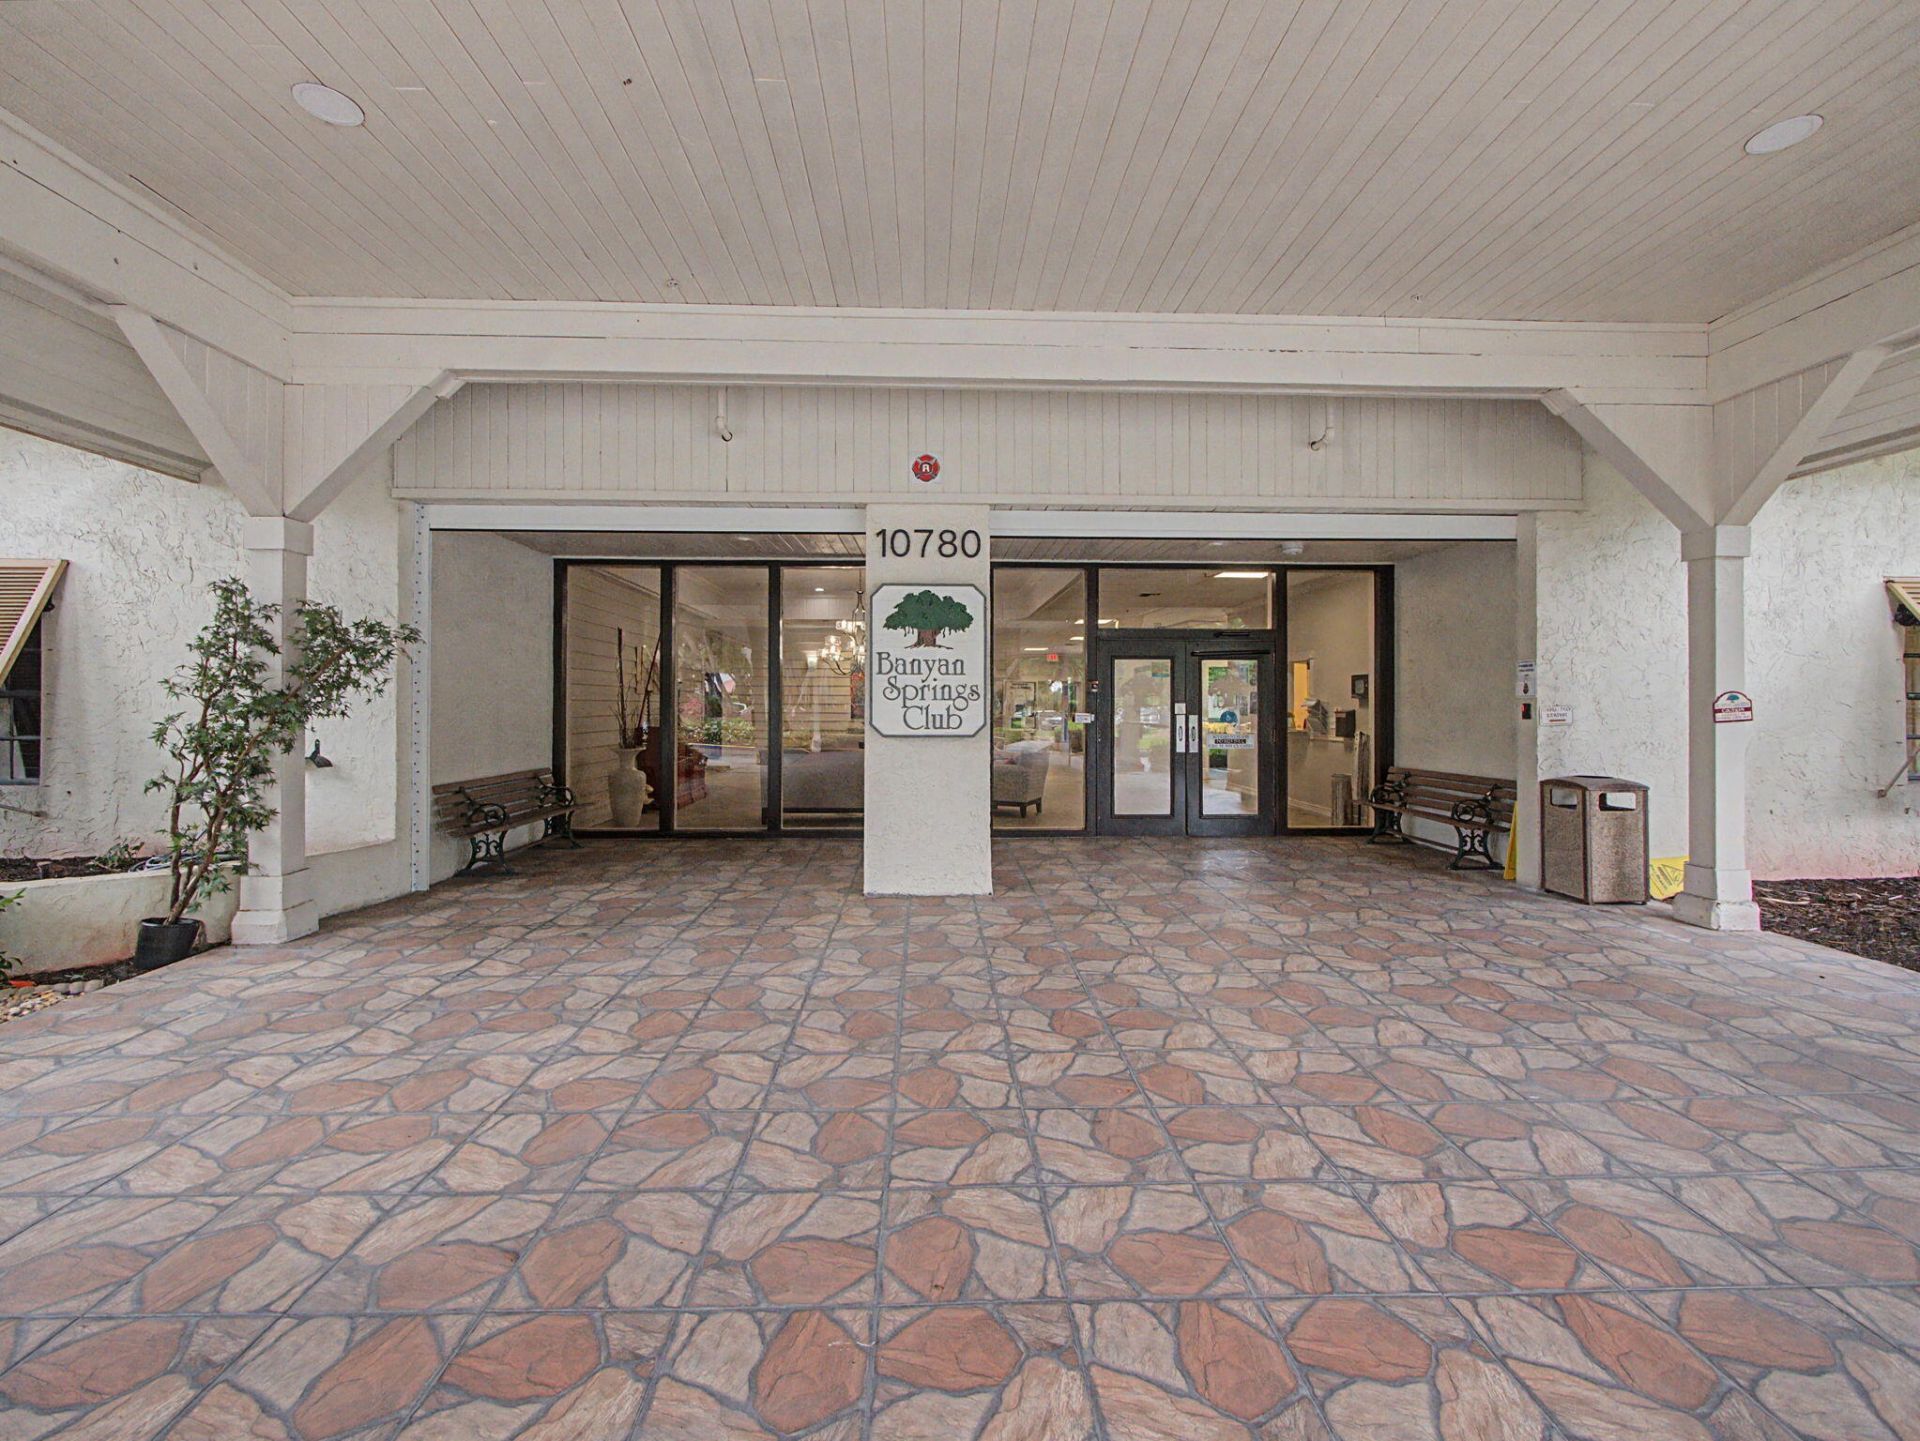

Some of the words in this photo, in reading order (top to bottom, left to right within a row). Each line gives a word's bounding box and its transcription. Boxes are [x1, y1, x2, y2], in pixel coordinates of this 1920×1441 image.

[876, 528, 981, 558] 10780
[876, 651, 966, 683] Banyan
[883, 675, 981, 711] Springs
[903, 704, 963, 730] Club
